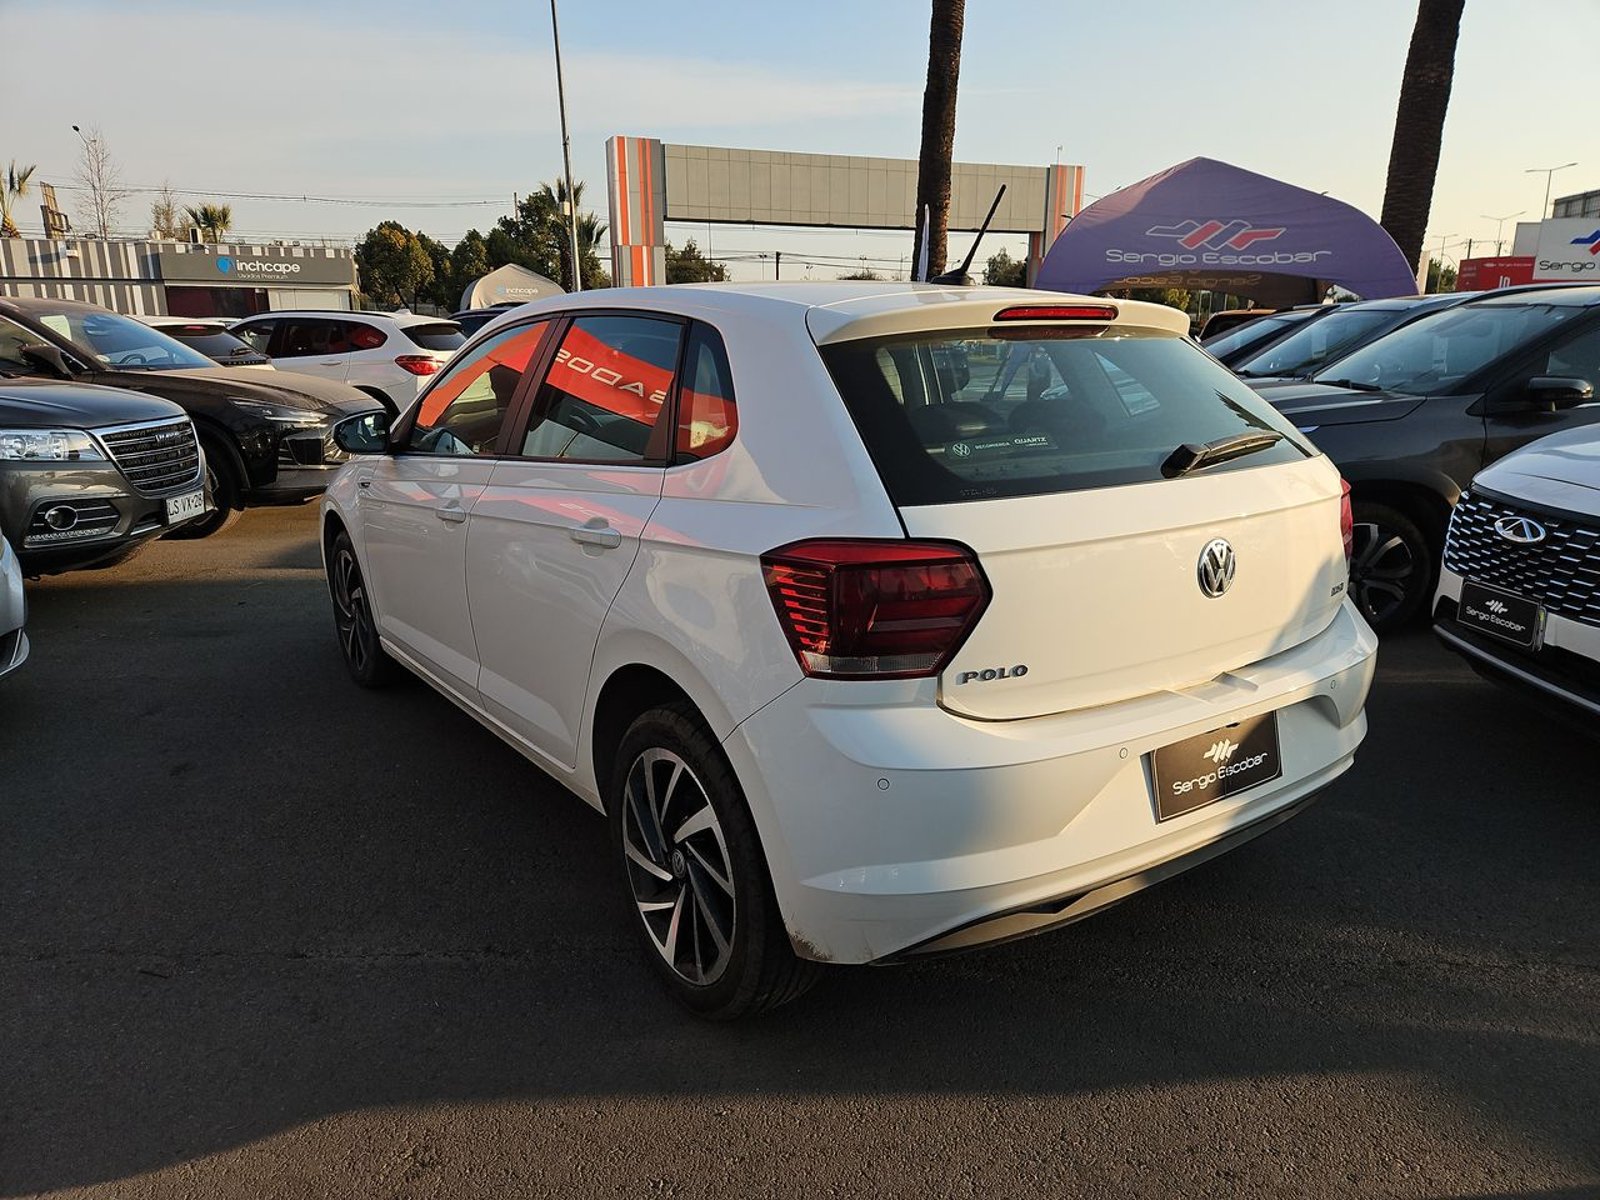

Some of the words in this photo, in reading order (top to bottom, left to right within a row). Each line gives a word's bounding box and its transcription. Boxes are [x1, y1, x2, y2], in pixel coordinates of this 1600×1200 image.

[1105, 249, 1197, 266] Sergio
[1202, 250, 1332, 265] Escobar
[236, 260, 301, 275] inchcape
[1539, 260, 1596, 273] Sergio
[505, 287, 539, 295] inchcape
[1014, 436, 1048, 445] QUARTZ
[1490, 614, 1526, 632] Escobar
[955, 664, 1029, 686] POLO
[1217, 752, 1268, 780] Escobar
